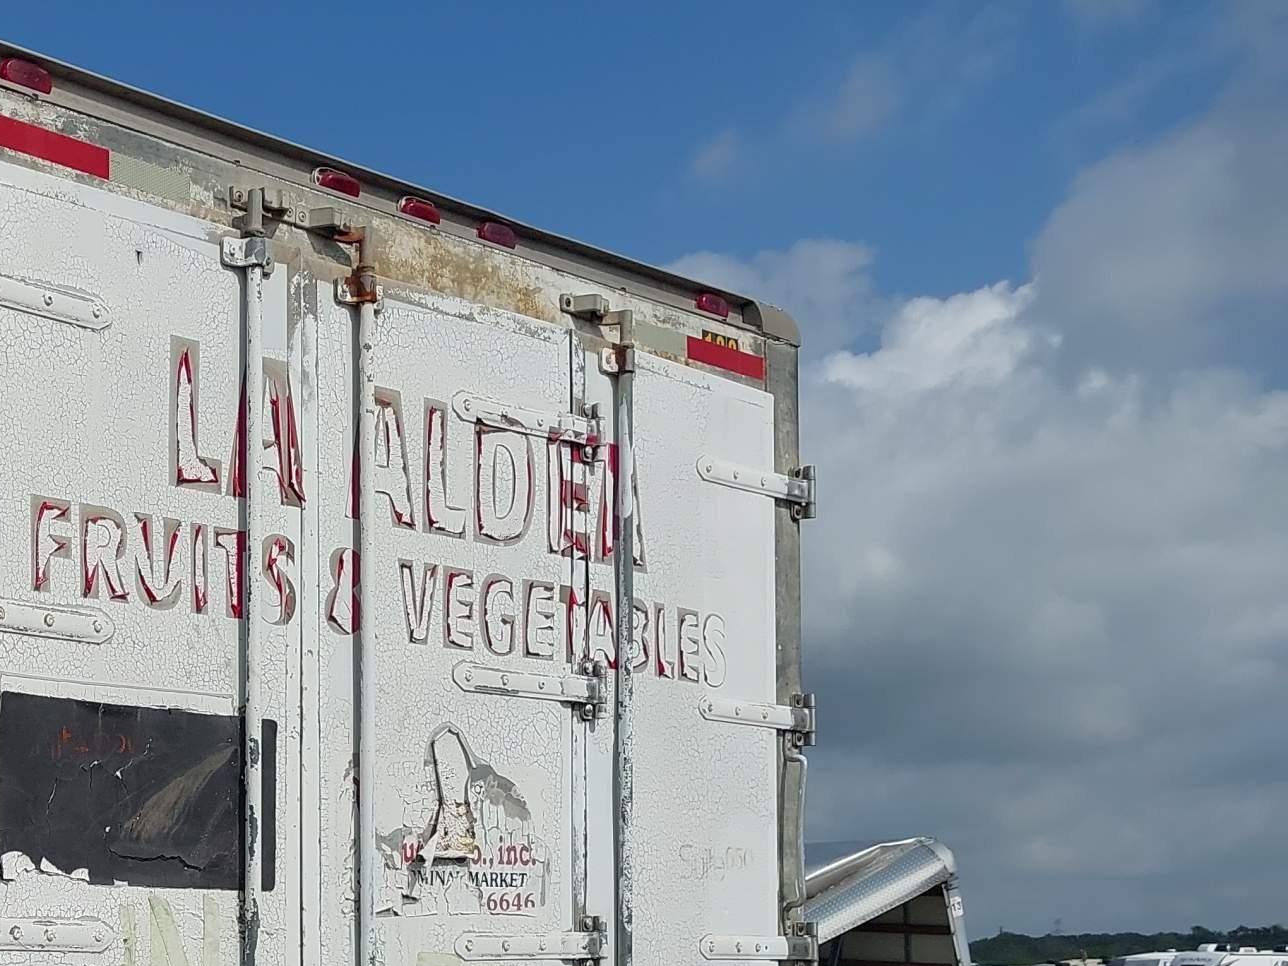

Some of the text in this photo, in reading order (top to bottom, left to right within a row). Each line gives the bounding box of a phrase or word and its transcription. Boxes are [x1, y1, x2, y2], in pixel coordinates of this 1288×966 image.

[170, 335, 648, 575] LA ALDEA
[30, 494, 297, 626] FRUITS
[398, 557, 727, 688] VEGETABLES
[469, 872, 527, 888] MARKET
